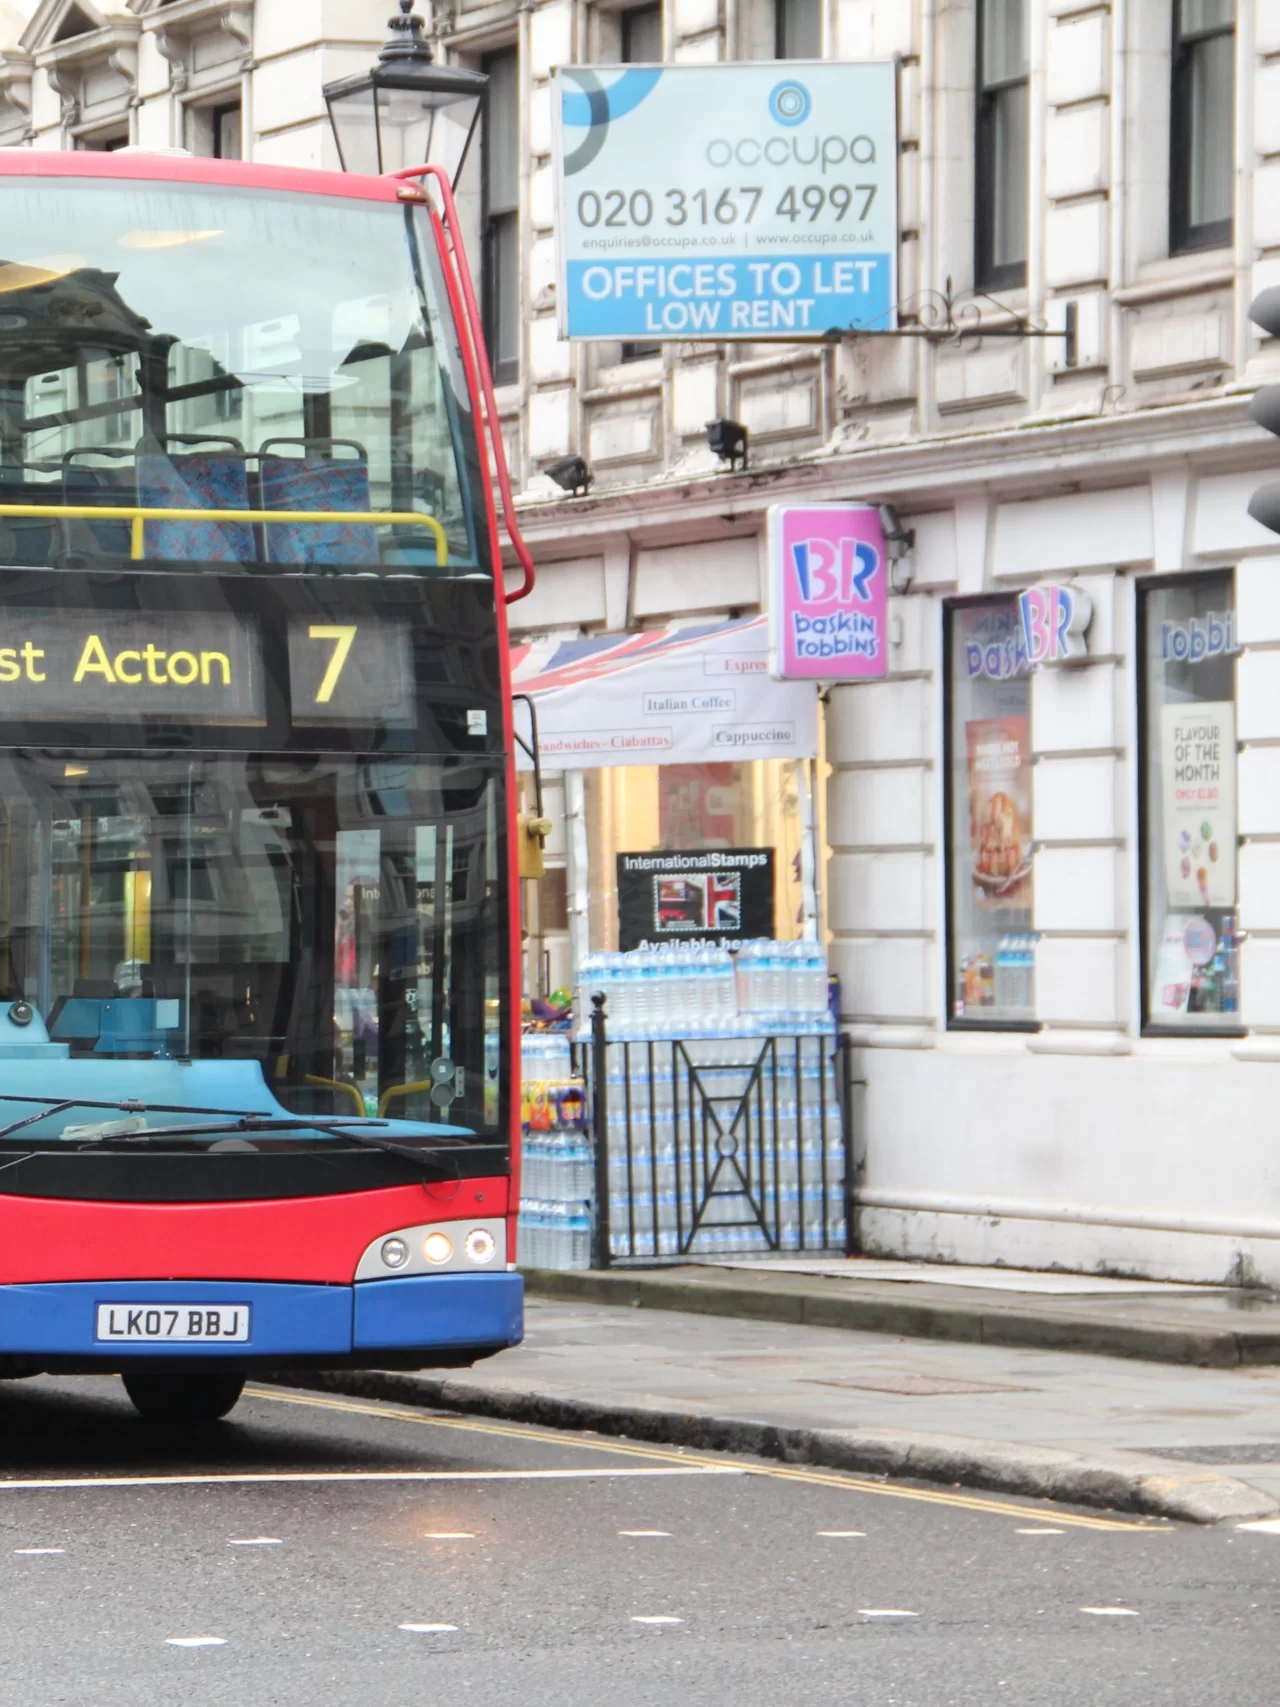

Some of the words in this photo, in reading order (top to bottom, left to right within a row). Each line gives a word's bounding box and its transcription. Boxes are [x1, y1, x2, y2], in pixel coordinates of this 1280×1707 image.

[706, 134, 876, 174] occupa
[577, 188, 653, 228] 020
[665, 187, 763, 226] 3167
[775, 183, 878, 223] 4997
[582, 232, 737, 250] enquiries@occupa.co.uk
[756, 229, 875, 245] www.occupa.co.uk
[581, 263, 737, 299] OFFICES
[747, 261, 802, 296] TO
[813, 260, 878, 295] LET
[645, 302, 721, 331] LOW
[731, 299, 816, 328] RENT
[792, 538, 879, 603] BR
[793, 610, 876, 635] baskin
[1020, 585, 1073, 662] BR
[796, 635, 879, 658] robbins
[1161, 611, 1238, 663] robbi
[72, 634, 231, 685] Acton
[308, 625, 358, 702] 7
[723, 658, 768, 674] Expres
[647, 698, 688, 711] Italian
[691, 696, 732, 709] Coffee
[610, 734, 670, 748] Ciabattas
[715, 729, 792, 745] Cappuccino
[1174, 725, 1221, 741] FLAVOUR
[1174, 743, 1192, 761] OF
[1195, 743, 1221, 760] THE
[1174, 763, 1221, 781] MONTH
[625, 853, 767, 869] InternationalStamps
[109, 1310, 179, 1336] LK07
[187, 1311, 239, 1336] BBJ
